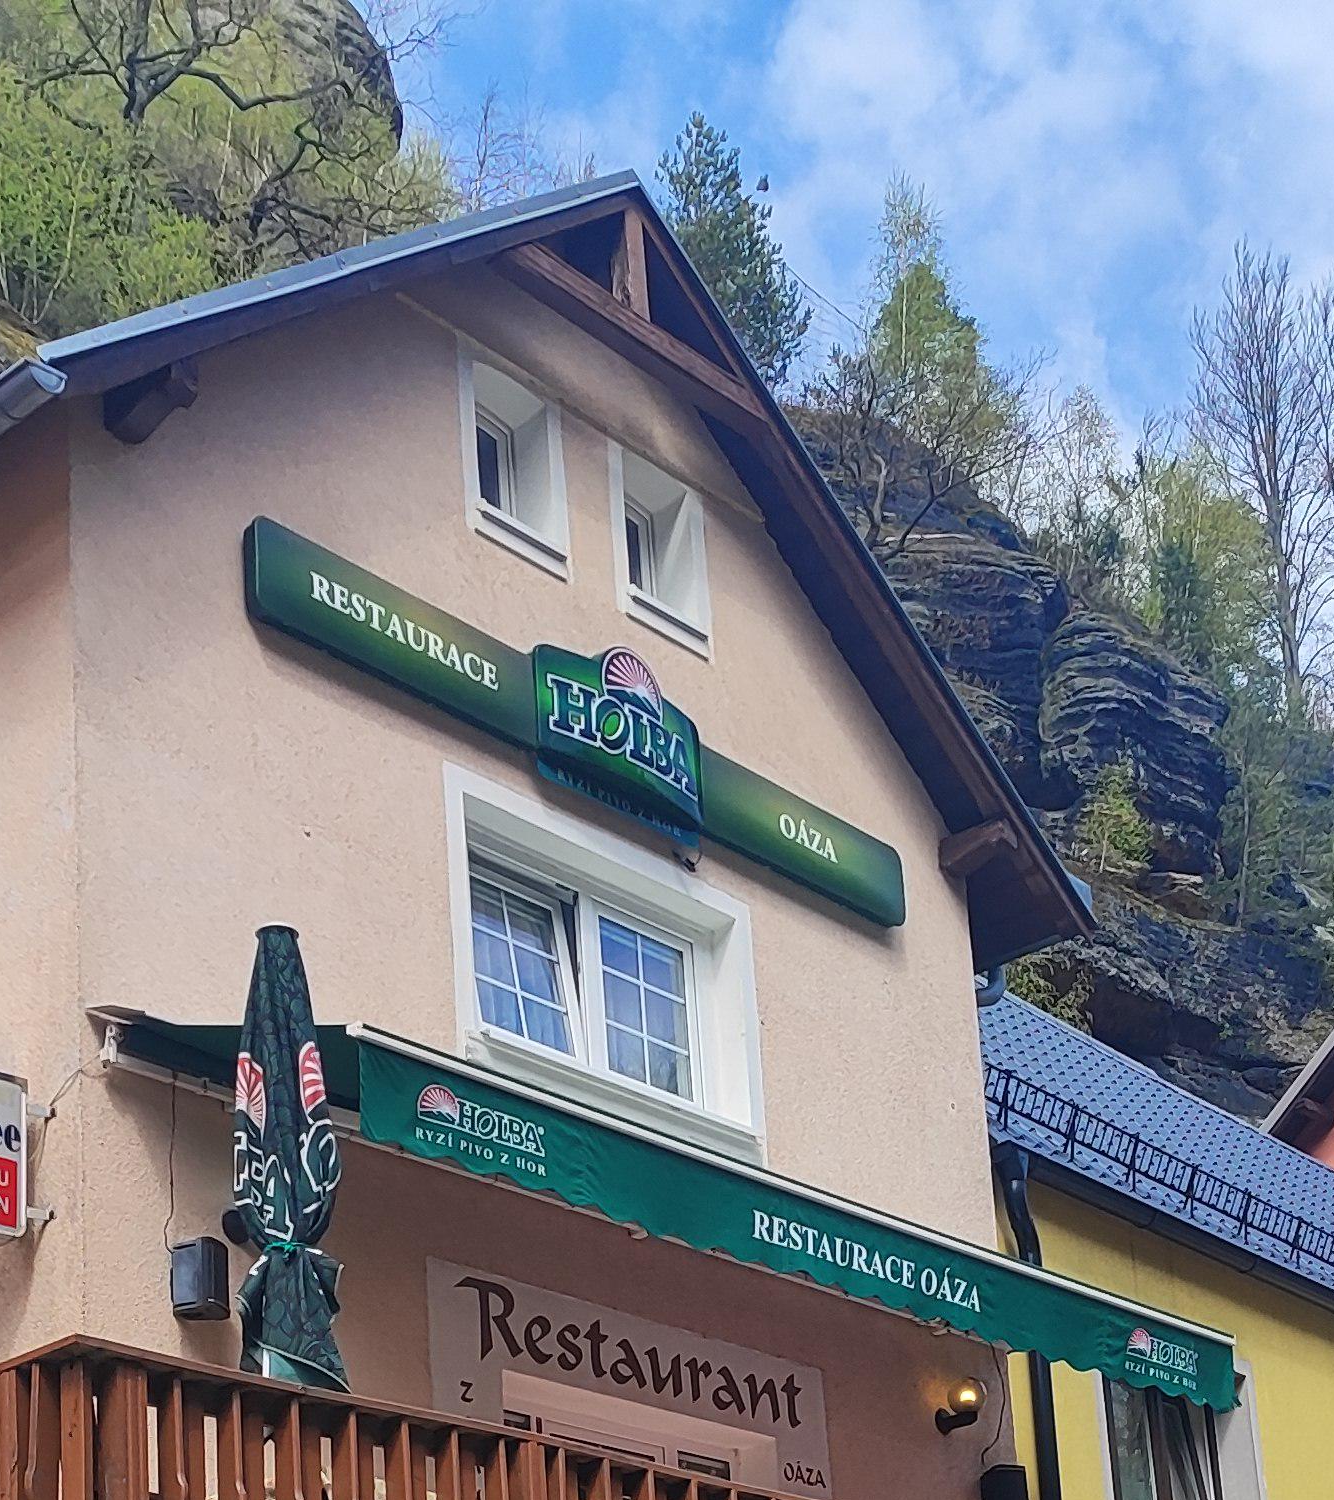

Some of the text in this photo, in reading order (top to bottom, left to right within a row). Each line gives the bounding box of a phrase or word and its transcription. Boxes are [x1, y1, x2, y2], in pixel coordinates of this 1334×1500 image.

[309, 569, 500, 692] RESTAURACE
[546, 672, 699, 801] HOLBA
[415, 1126, 547, 1177] RYZÍ PIVO Z HOR
[456, 1097, 546, 1158] HOLBA
[751, 1208, 982, 1314] RESTAURACE OÁZA
[454, 1276, 803, 1430] Restaurant
[783, 1459, 827, 1489] OÁZA
